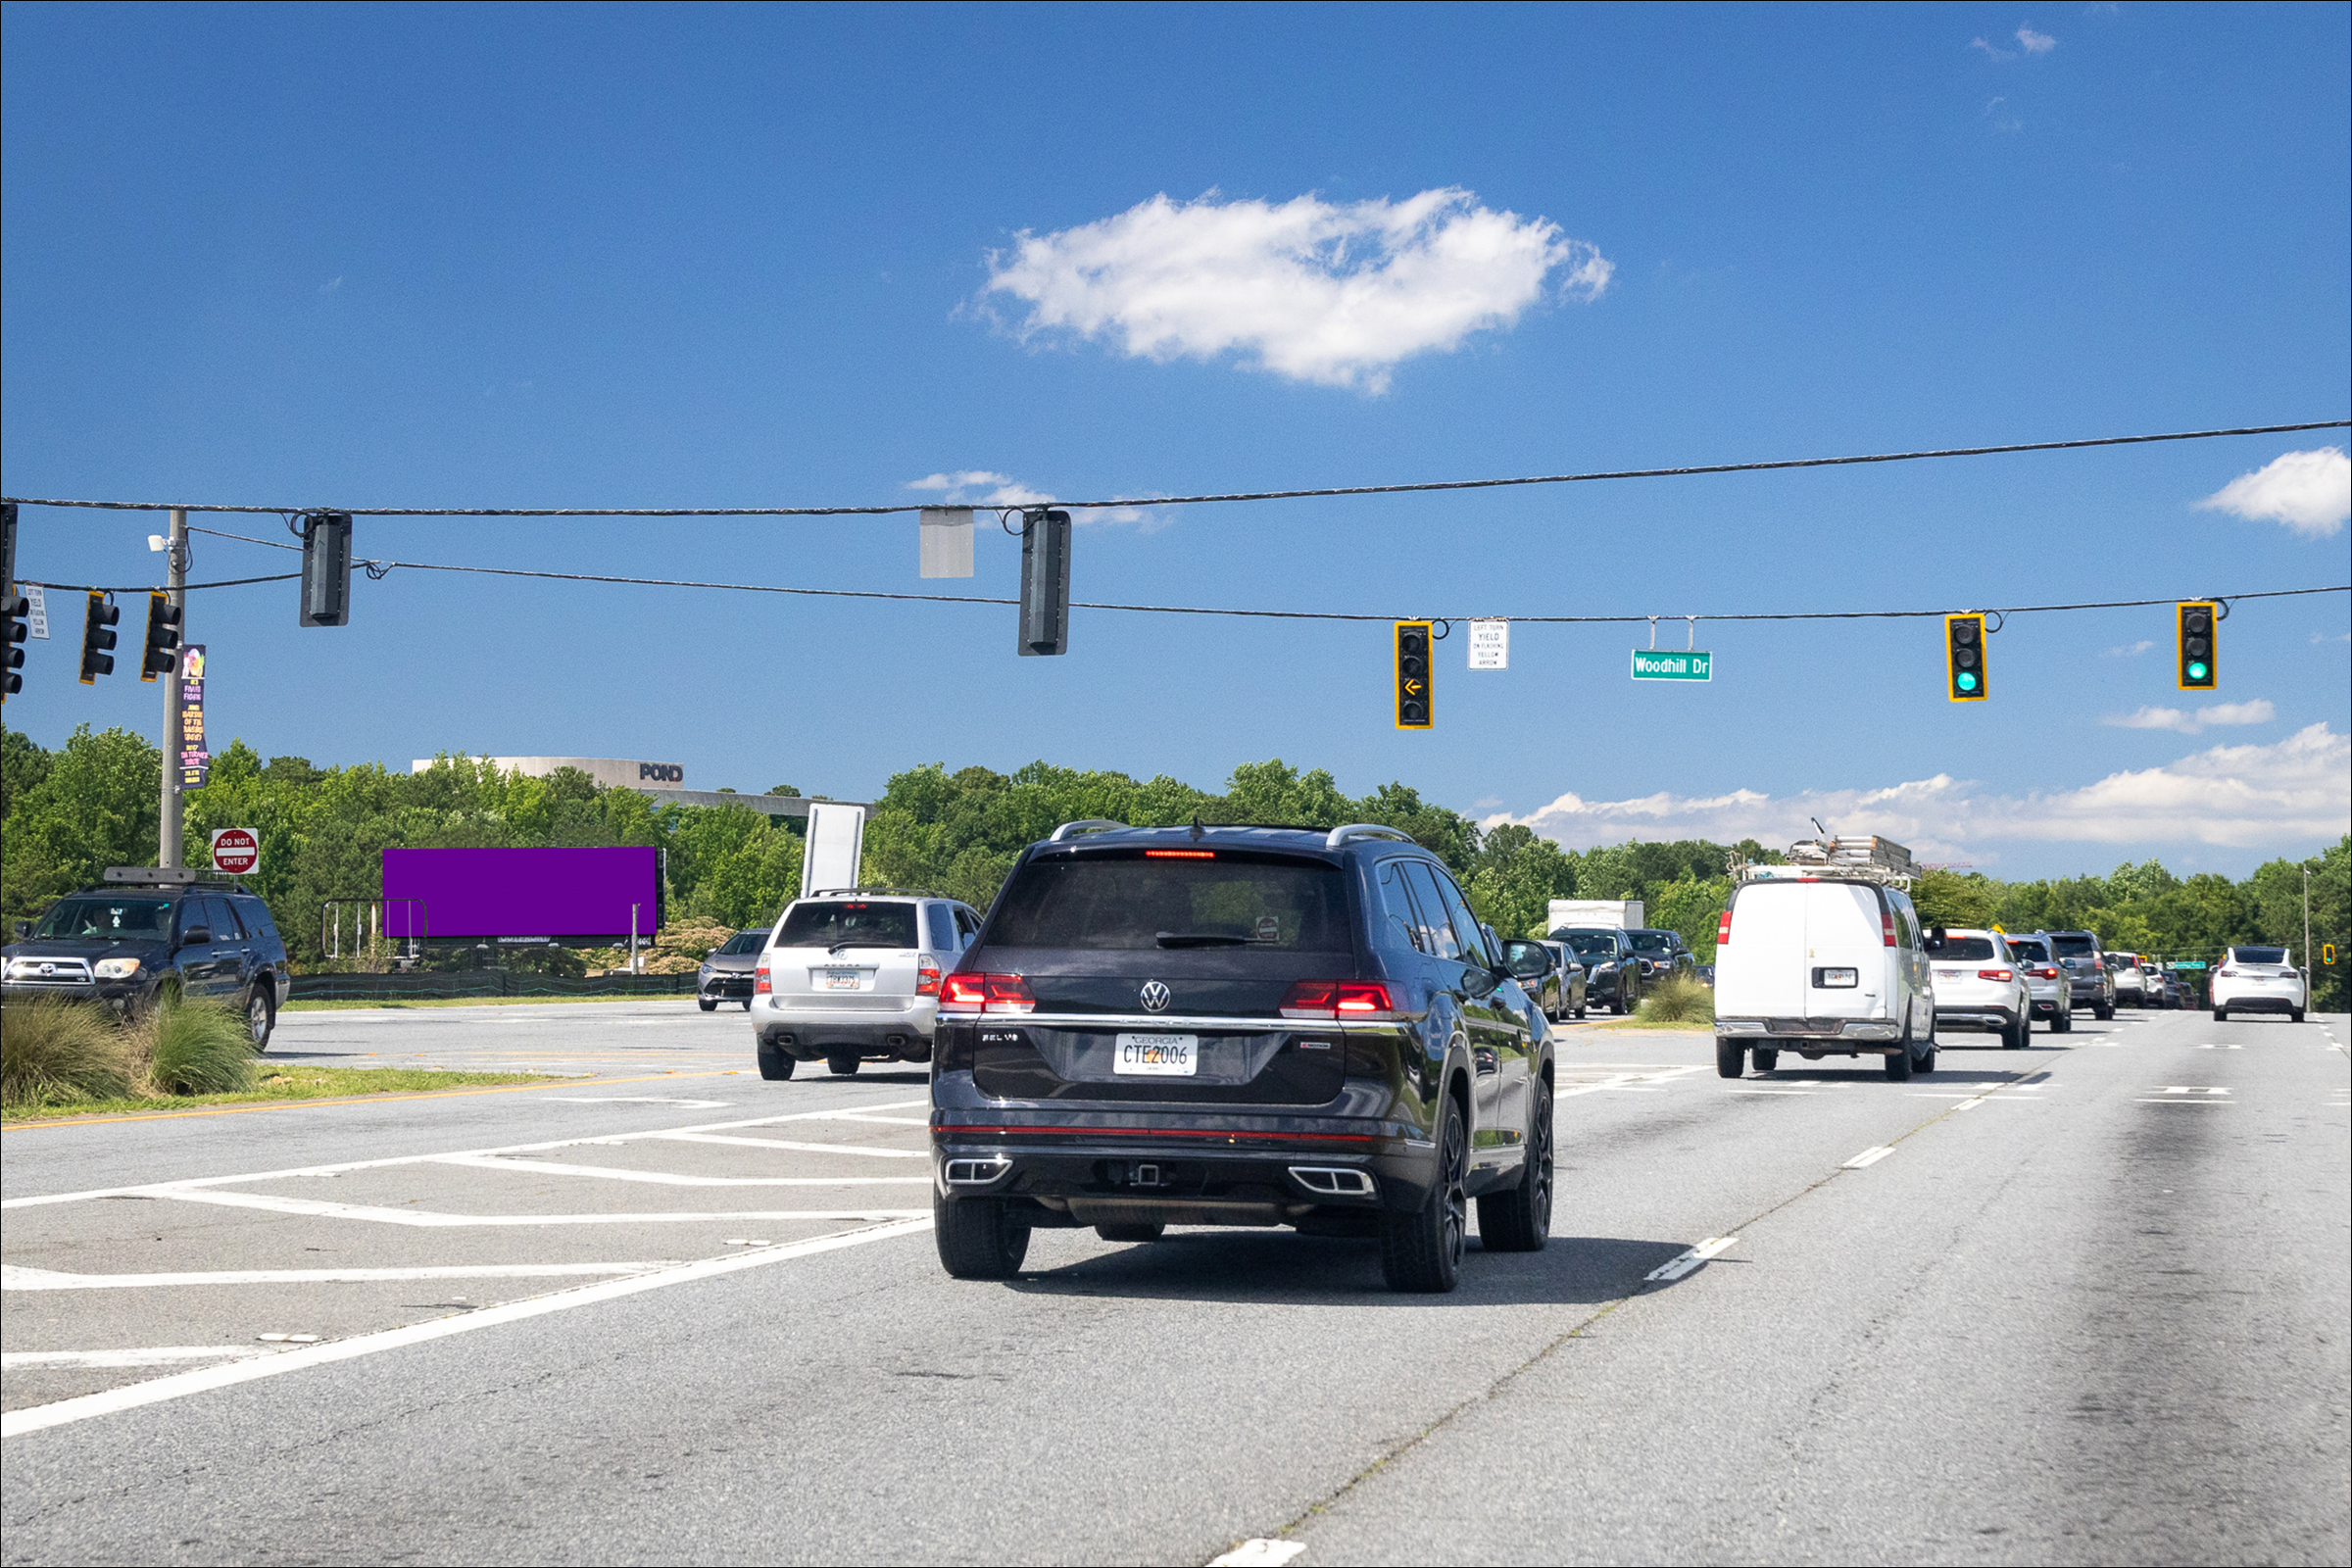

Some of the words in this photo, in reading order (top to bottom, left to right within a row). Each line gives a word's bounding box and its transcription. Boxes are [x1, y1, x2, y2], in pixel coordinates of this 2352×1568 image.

[1478, 632, 1499, 641] YIELD
[1635, 657, 1687, 673] Woodhill
[1692, 658, 1709, 673] Dr
[640, 763, 683, 782] POND
[1134, 1036, 1178, 1045] GEORGIA
[1124, 1045, 1187, 1064] CTE2006
